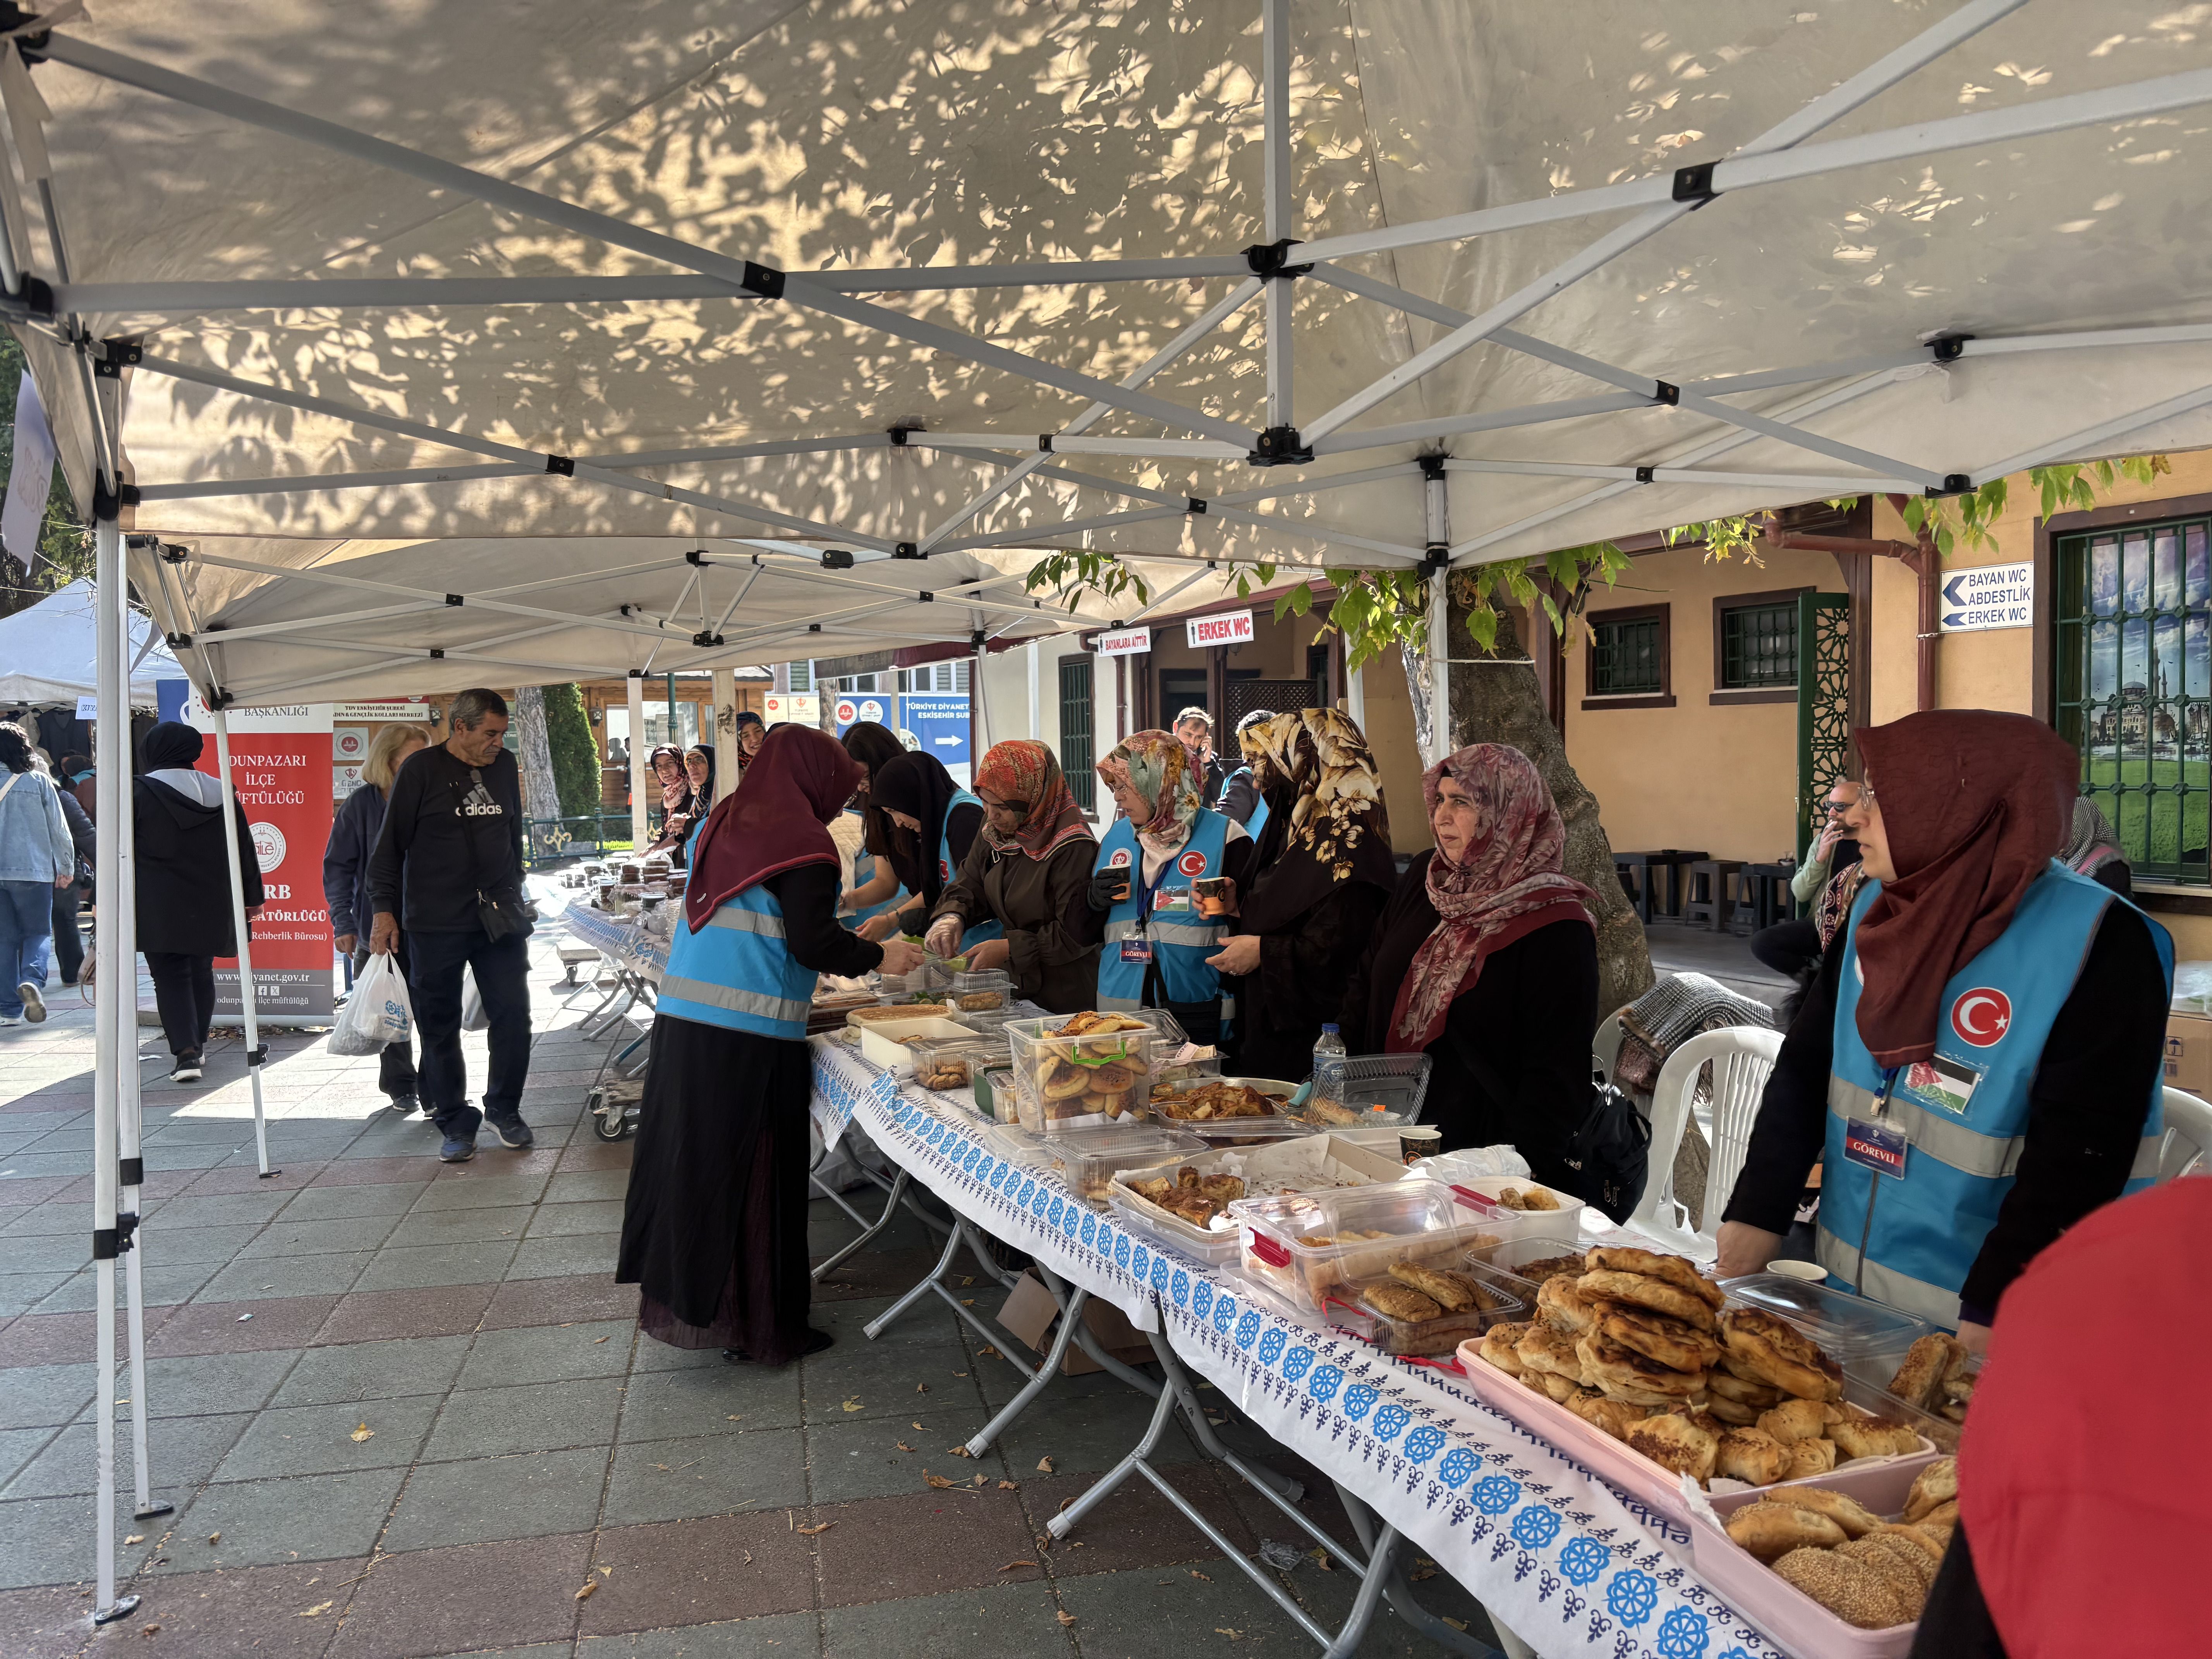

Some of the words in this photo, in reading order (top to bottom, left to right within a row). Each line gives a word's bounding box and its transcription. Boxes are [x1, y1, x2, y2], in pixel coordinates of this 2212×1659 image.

[1969, 571, 2004, 587] BAYAN
[2008, 569, 2026, 582] WC
[1968, 586, 2031, 606] ABDESTLİK
[1969, 609, 2005, 624] ERKEK
[2009, 607, 2027, 621] WC
[1198, 619, 1232, 641] ERKEK
[1233, 617, 1250, 636] WC
[1106, 637, 1131, 651] BAYANLARA
[245, 706, 308, 718] BAŞKANLIĞI
[229, 755, 306, 766] DUNPAZARI
[246, 772, 275, 788] İLÇE
[235, 791, 304, 804] ÜFTÜLÜĞÜ
[252, 931, 292, 940] Rehberlik
[295, 932, 327, 941] Bürosu)
[217, 974, 310, 983] wwwyanet.gov.tr
[272, 997, 309, 1005] müftülüğü
[1853, 1142, 1894, 1163] GÖREVLİ
